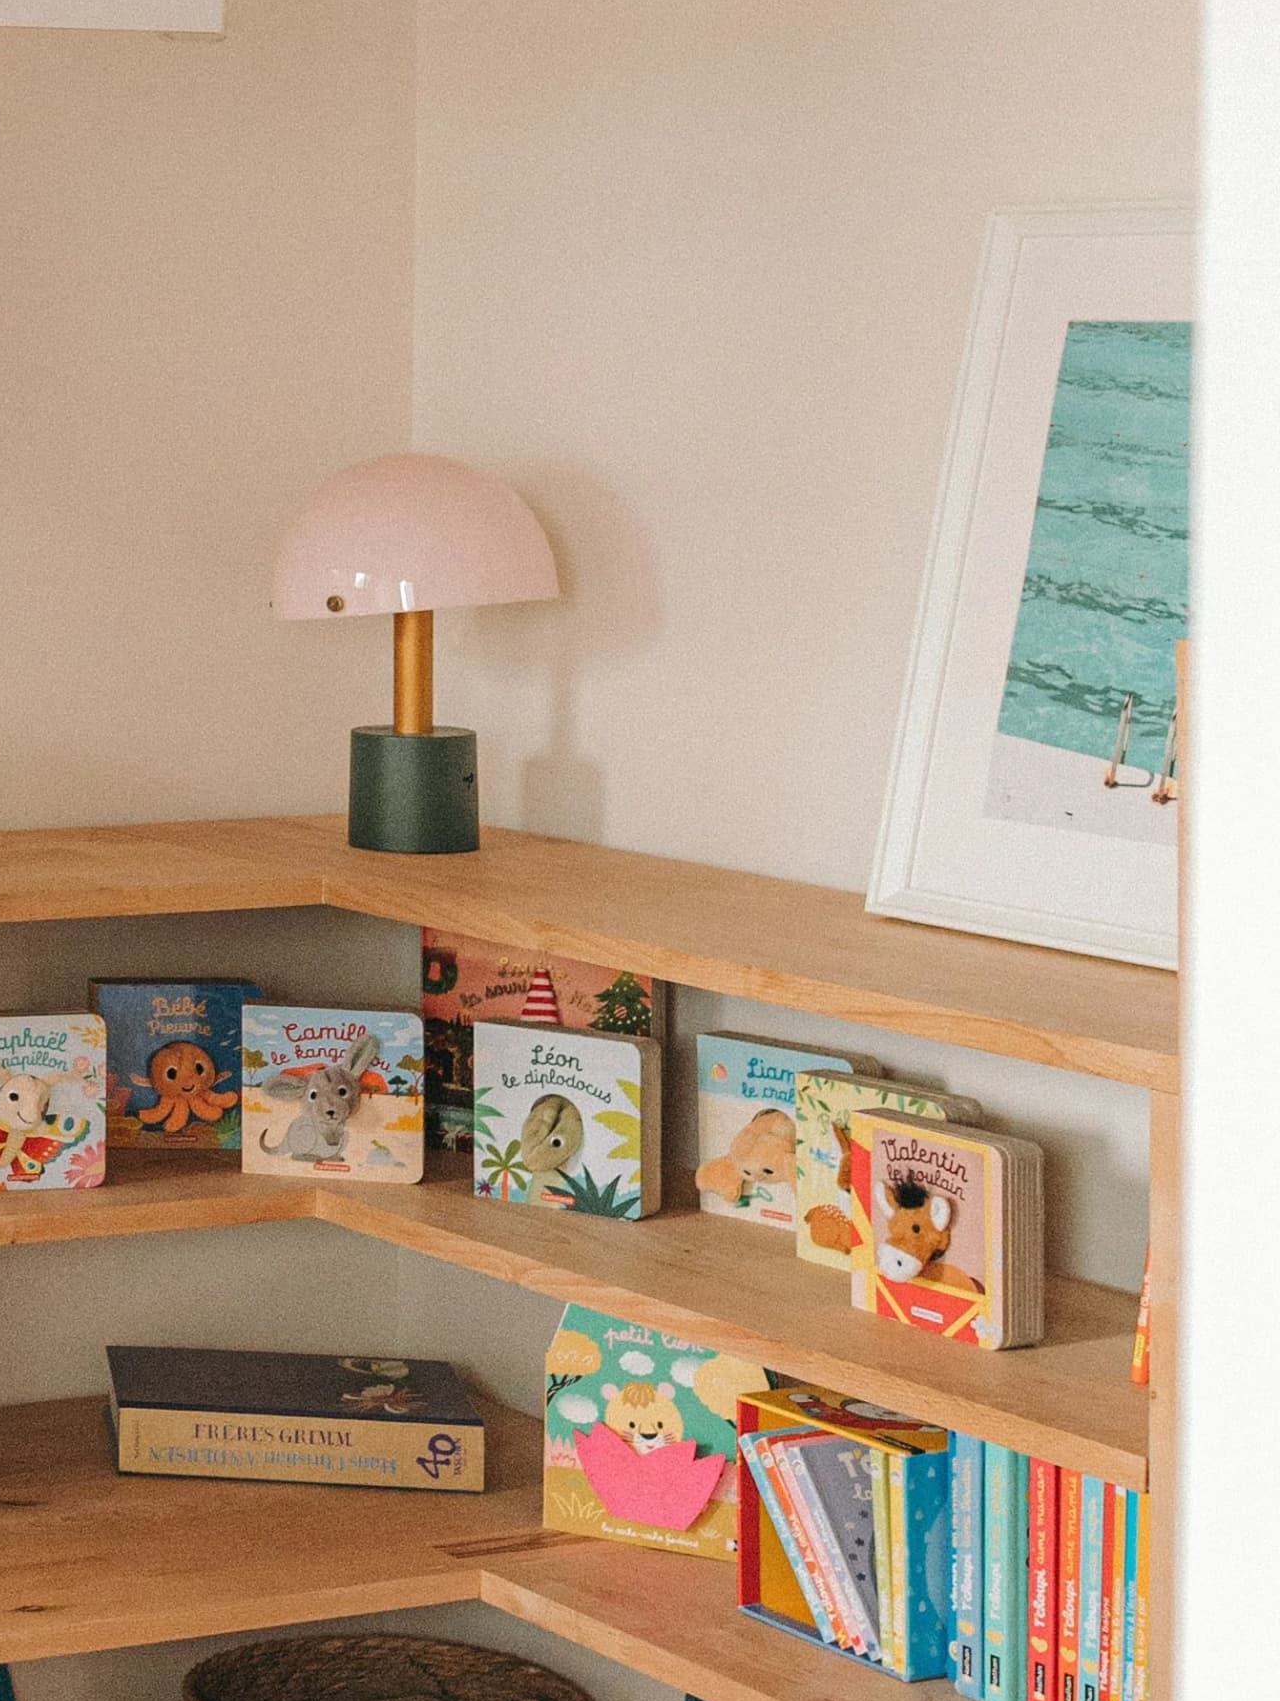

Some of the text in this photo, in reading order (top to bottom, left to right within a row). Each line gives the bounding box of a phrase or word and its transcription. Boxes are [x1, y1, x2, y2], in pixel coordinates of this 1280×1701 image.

[151, 997, 208, 1018] Bébé
[282, 1022, 367, 1043] Camill
[1, 1051, 68, 1072] papillon
[271, 1051, 289, 1065] le
[531, 1045, 583, 1071] Léon
[502, 1069, 612, 1104] le diplodocus
[741, 1083, 758, 1099] le
[881, 1138, 969, 1183] Valentin
[887, 1163, 967, 1201] le poulain
[604, 1325, 654, 1349] petit
[193, 1421, 353, 1447] FRÈRES GRIMM
[415, 1433, 457, 1479] 40
[1034, 1465, 1046, 1524] maman
[1065, 1476, 1078, 1535] mamie
[1035, 1530, 1046, 1563] aime
[1065, 1539, 1075, 1572] aime
